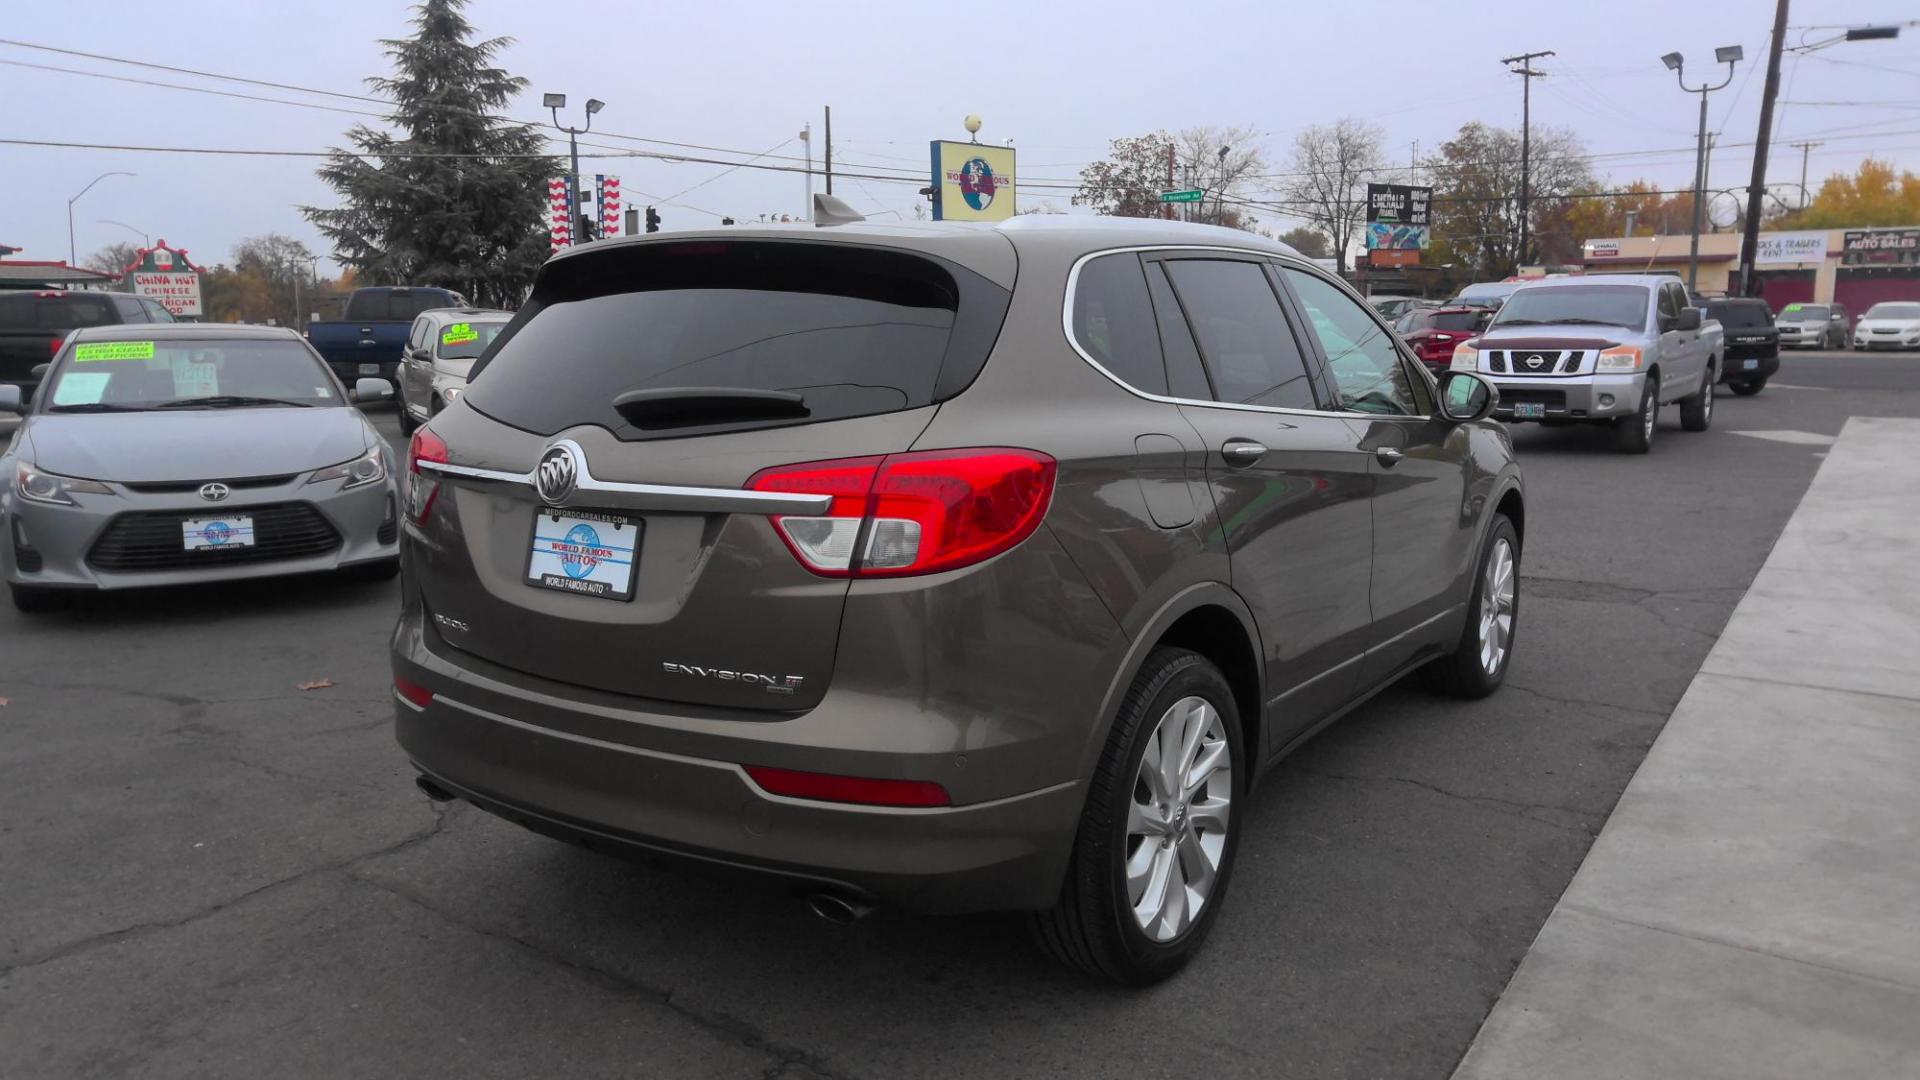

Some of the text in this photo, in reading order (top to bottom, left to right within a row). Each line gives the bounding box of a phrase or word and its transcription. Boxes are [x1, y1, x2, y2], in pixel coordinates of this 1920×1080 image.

[1372, 193, 1404, 209] EMERALD
[1785, 238, 1821, 249] TRAILERS
[1849, 238, 1916, 249] AUTO SALES
[1763, 250, 1783, 259] RENT
[136, 275, 196, 285] CHINA HUT
[144, 287, 190, 295] CHINESE
[161, 299, 195, 307] RICAN
[545, 508, 627, 524] MEDFORDCARSALES.COM
[552, 542, 613, 557] WORLD FAMOUS
[563, 553, 597, 567] AUTOS
[545, 576, 604, 594] WORLD FAMOUS AUTO
[663, 662, 777, 685] ENVISION
